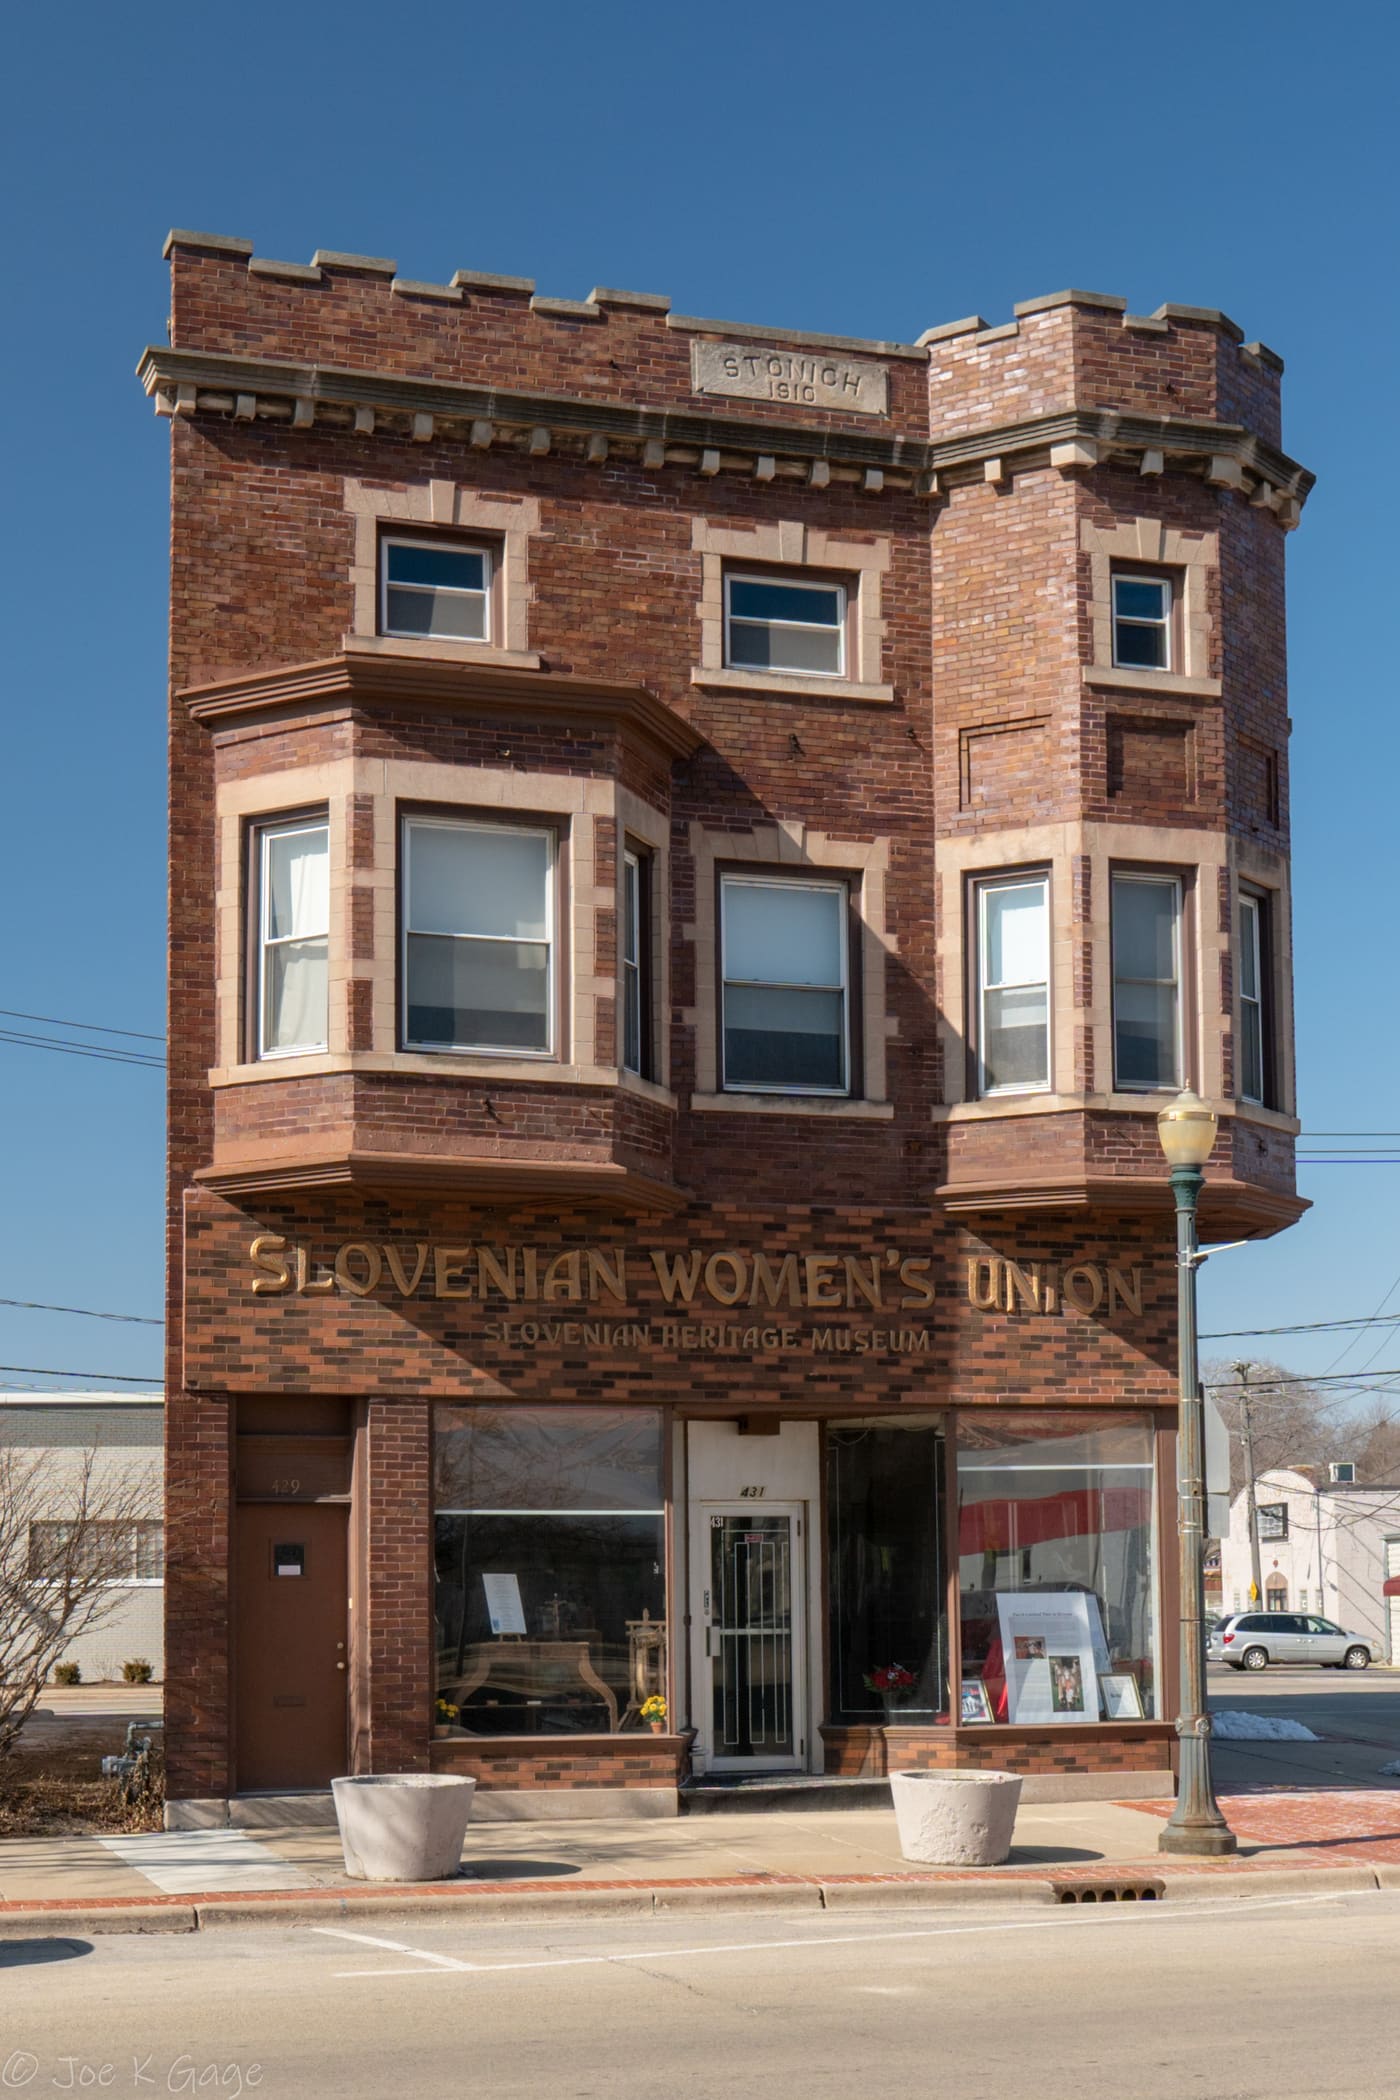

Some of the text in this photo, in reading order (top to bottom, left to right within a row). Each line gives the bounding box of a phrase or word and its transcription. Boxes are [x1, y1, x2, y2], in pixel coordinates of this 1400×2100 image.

[724, 356, 861, 396] STONICH
[769, 381, 816, 402] 1910
[249, 1235, 1143, 1317] SLOVENIAN WOMEN'S UNION
[484, 1321, 929, 1351] SLOVENIAN HERITAGE MUSEUM
[272, 1480, 300, 1496] 429
[740, 1486, 765, 1497] 431
